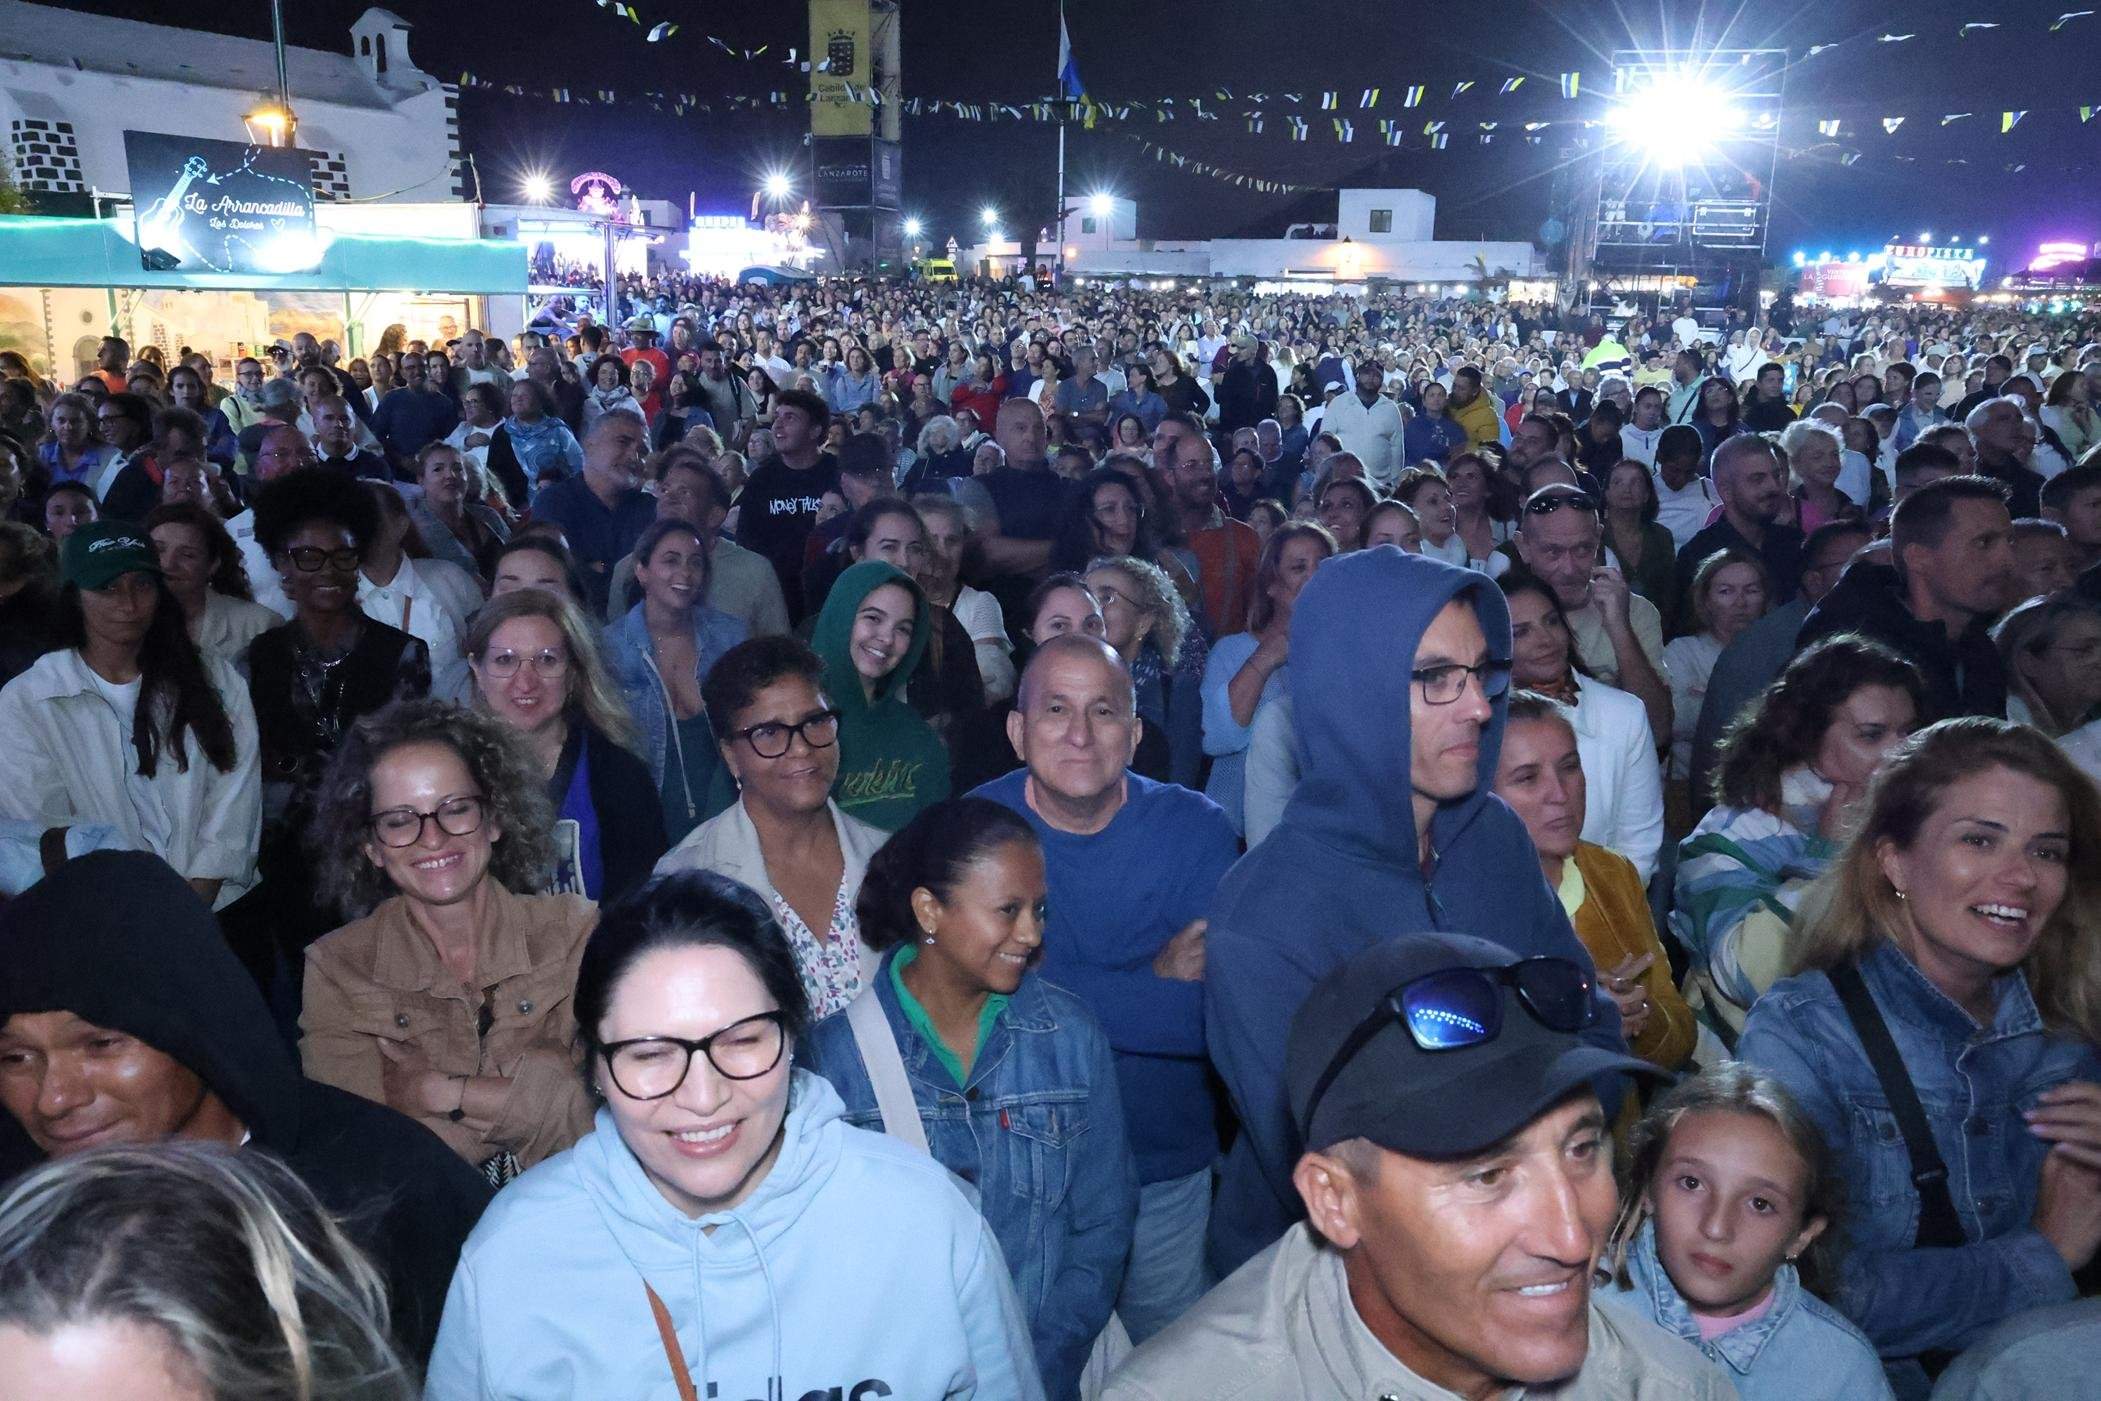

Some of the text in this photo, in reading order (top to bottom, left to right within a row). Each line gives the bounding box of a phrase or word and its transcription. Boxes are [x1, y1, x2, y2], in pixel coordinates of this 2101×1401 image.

[817, 169, 868, 178] LANZAROTE
[184, 192, 306, 217] La Arrancadilla
